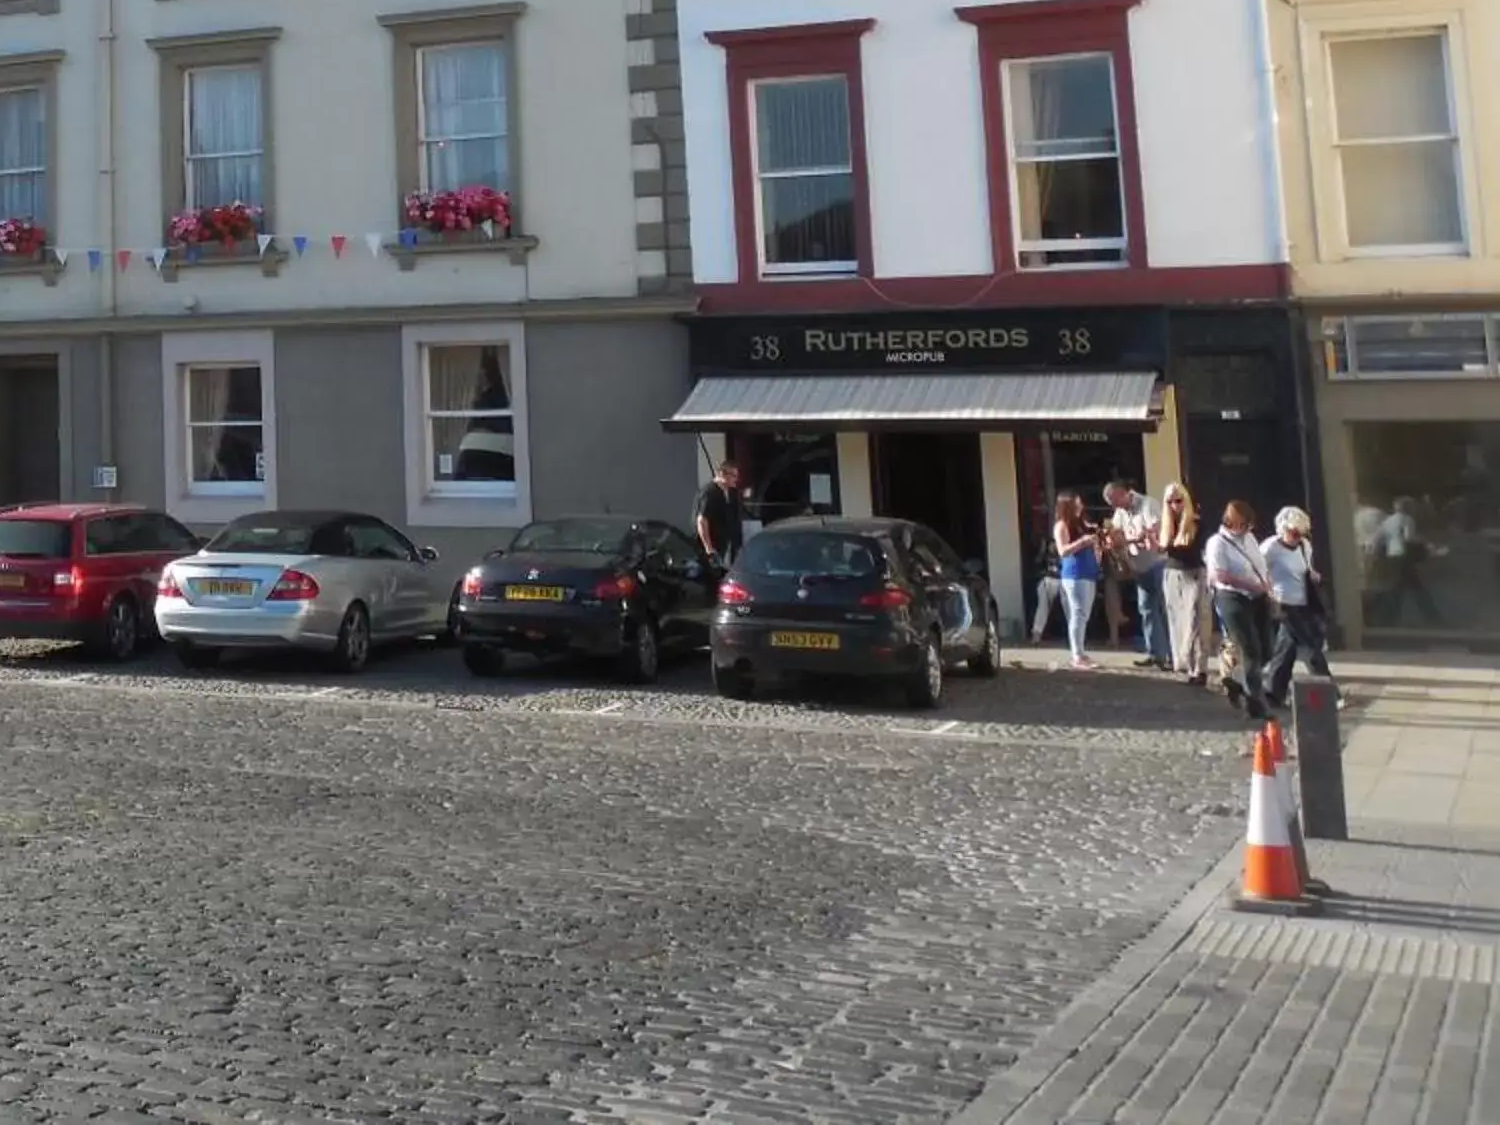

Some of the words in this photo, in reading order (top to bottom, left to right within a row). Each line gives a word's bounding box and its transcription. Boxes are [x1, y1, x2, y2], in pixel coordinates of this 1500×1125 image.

[751, 335, 781, 361] 38
[804, 327, 1029, 352] RUTHERFORDS
[1058, 327, 1092, 355] 38
[885, 350, 946, 363] MICROPUB
